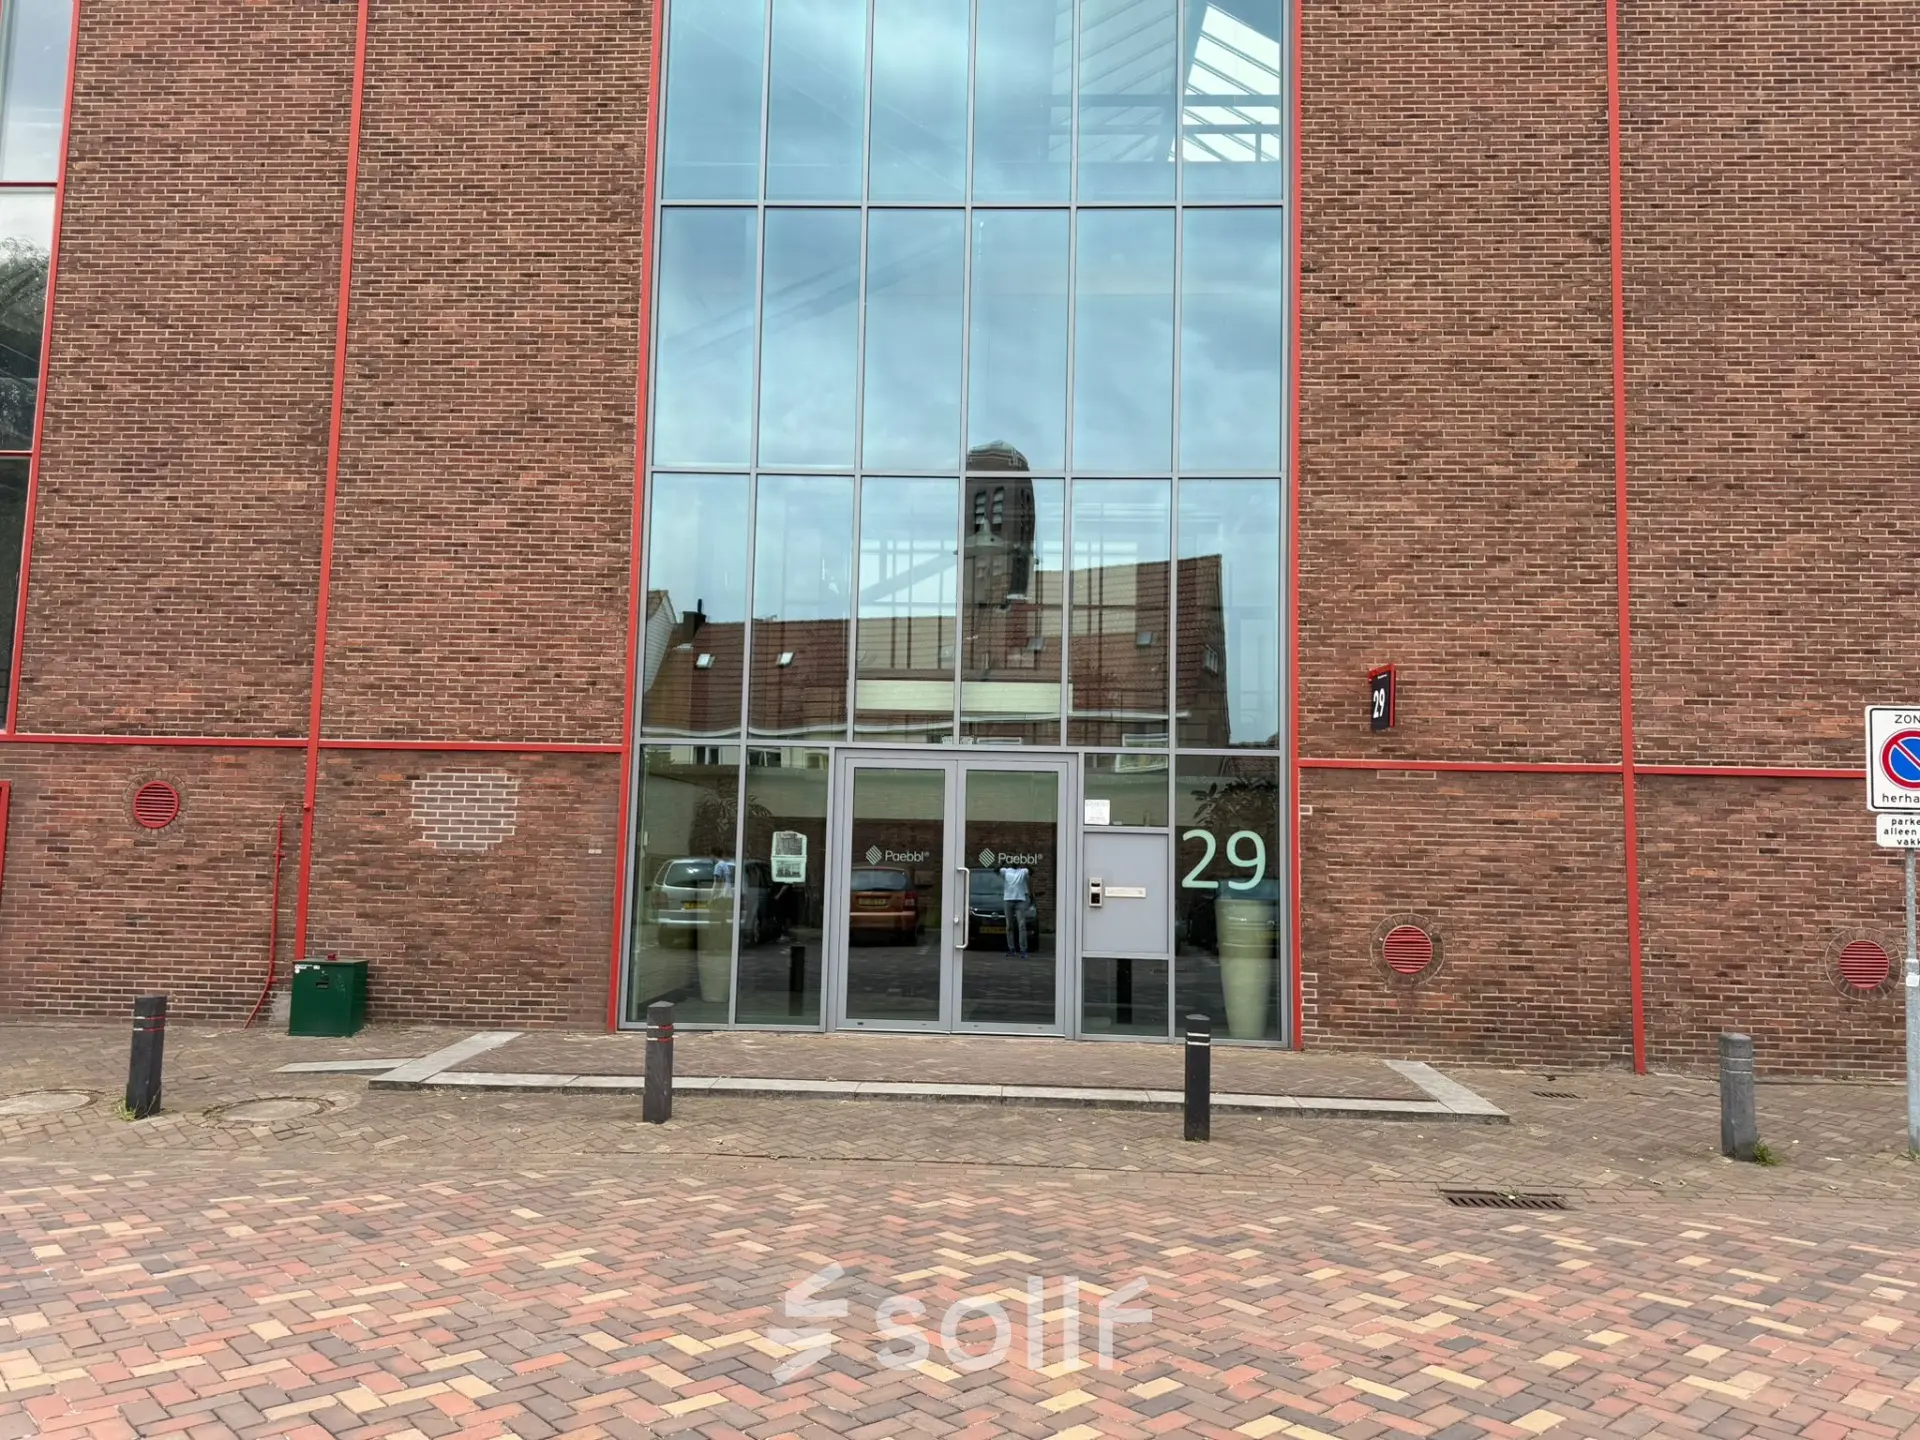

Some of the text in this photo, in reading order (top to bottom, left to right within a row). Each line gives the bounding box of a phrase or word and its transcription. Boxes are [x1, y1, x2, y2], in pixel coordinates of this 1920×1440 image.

[1373, 688, 1385, 718] 29
[1883, 827, 1917, 836] alleen
[1181, 829, 1266, 890] 29
